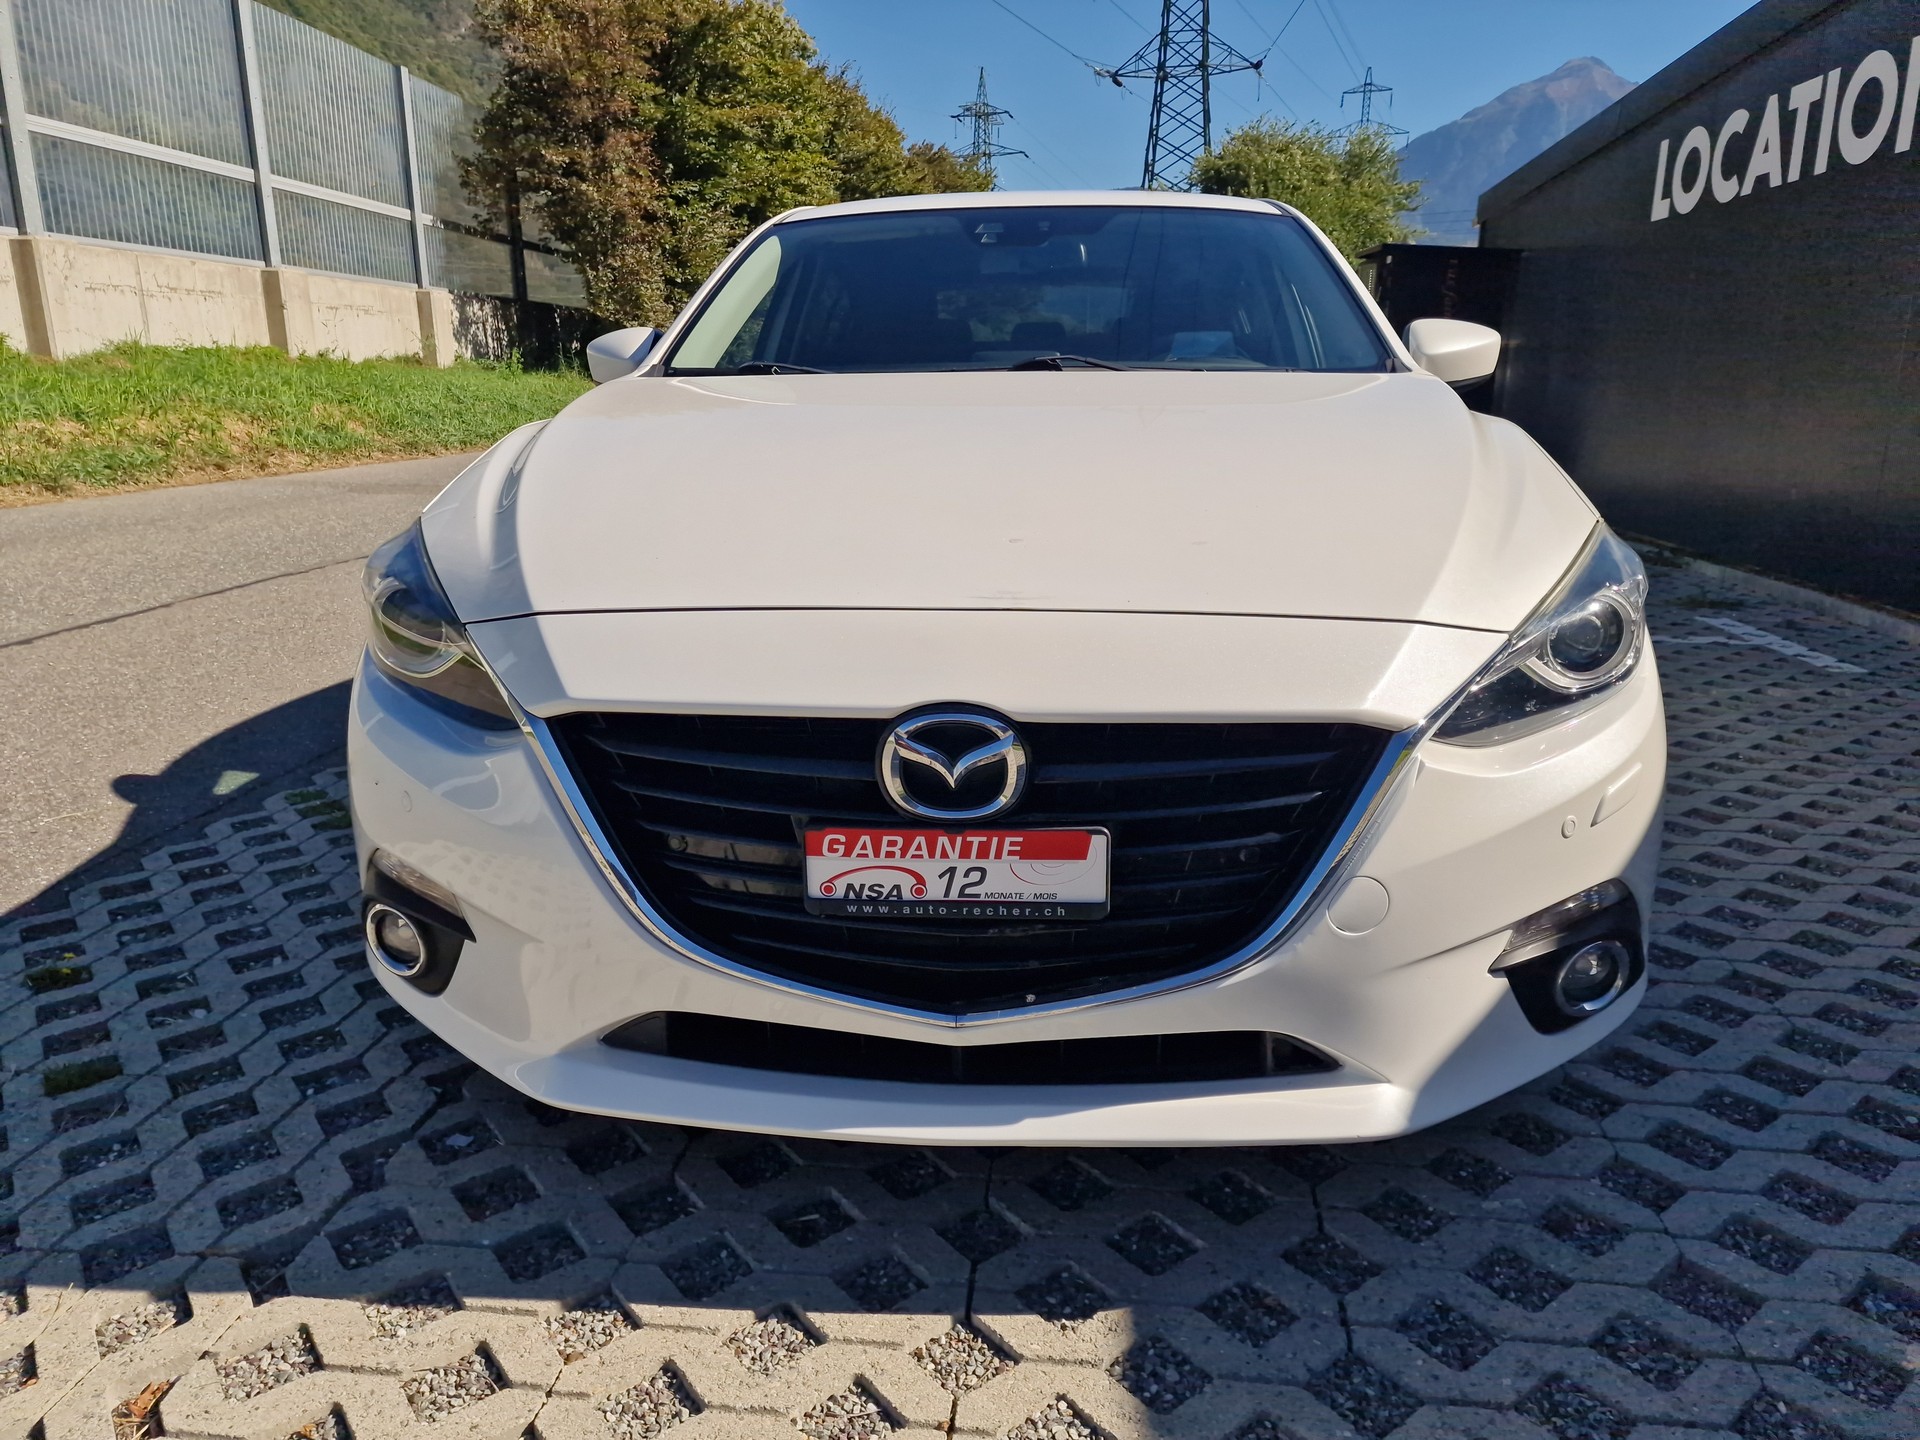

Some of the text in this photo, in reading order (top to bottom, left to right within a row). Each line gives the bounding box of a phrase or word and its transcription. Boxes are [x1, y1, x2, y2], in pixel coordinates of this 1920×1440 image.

[821, 834, 1024, 861] GARANTIE
[843, 883, 904, 900] NSA
[937, 866, 988, 899] 12
[984, 892, 1025, 900] MONATE
[847, 904, 1066, 917] www.auto-recher.ch
